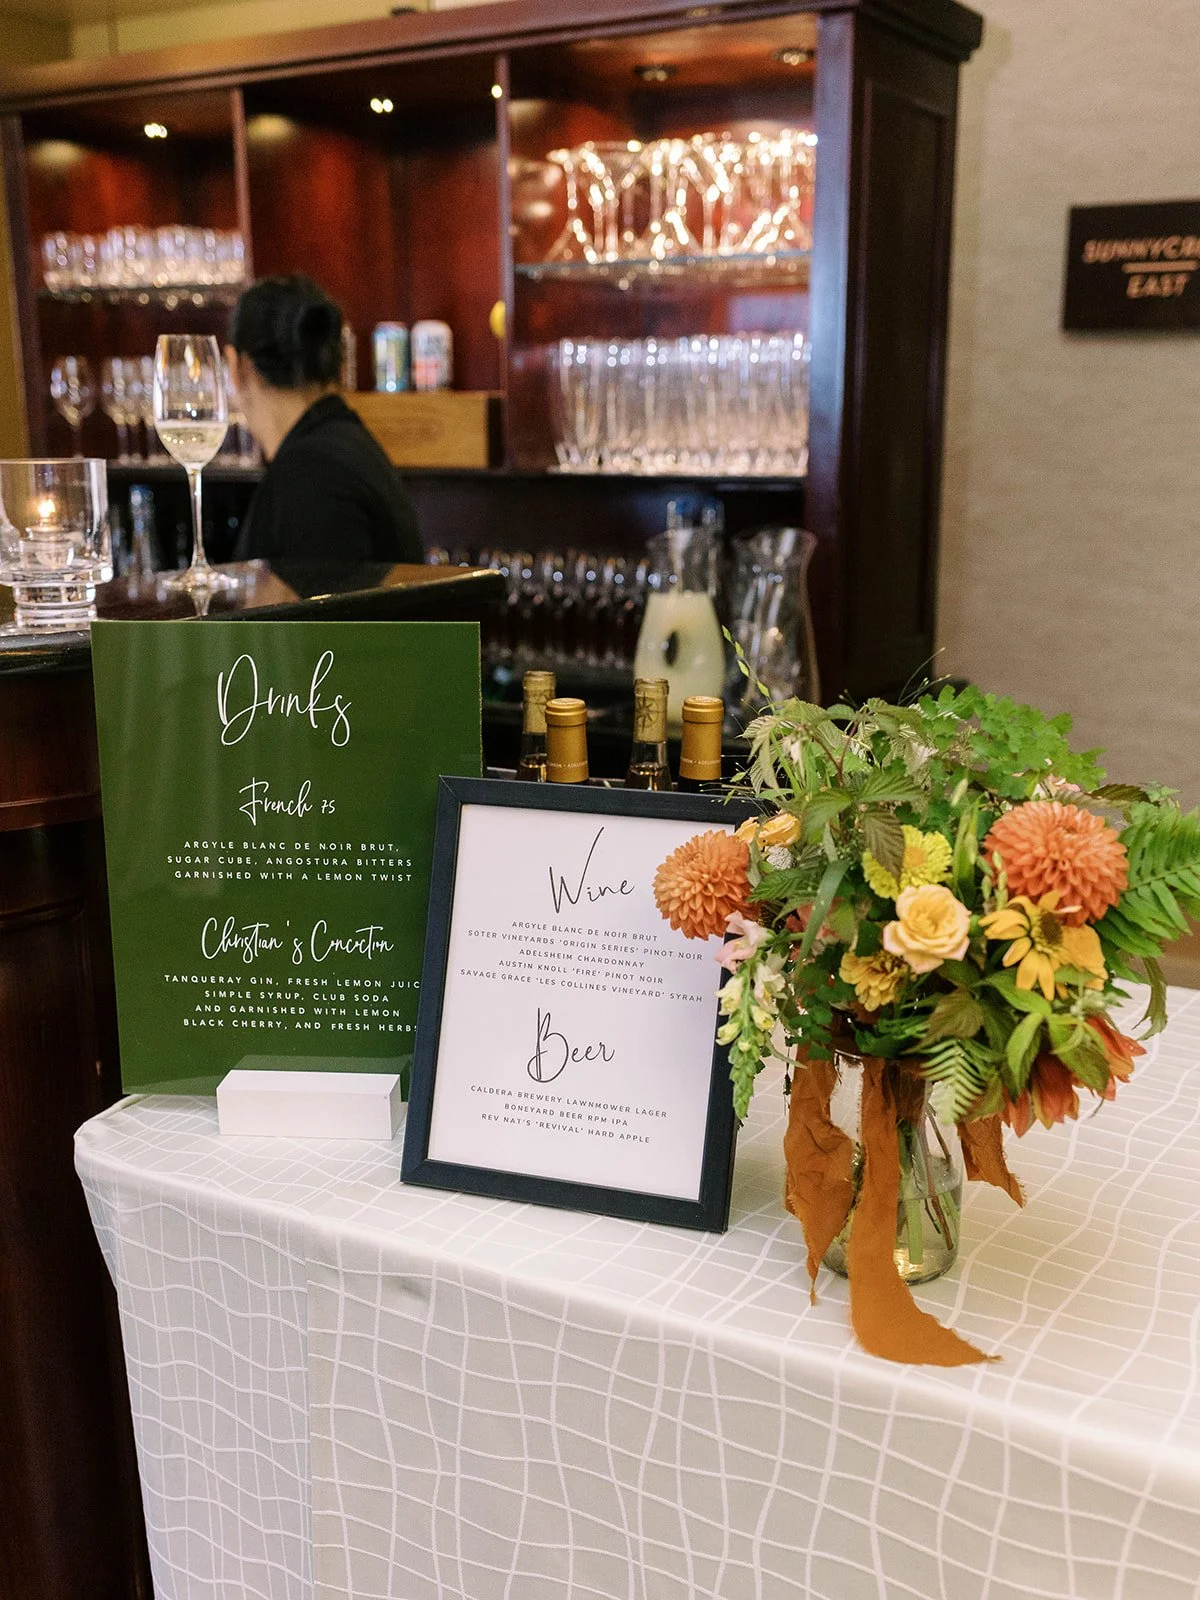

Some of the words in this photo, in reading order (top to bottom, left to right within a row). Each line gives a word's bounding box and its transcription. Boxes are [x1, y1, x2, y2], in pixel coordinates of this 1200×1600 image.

[1081, 235, 1200, 264] SUNNYCR
[1126, 273, 1189, 299] EAST
[217, 650, 352, 747] Drinks
[238, 777, 313, 826] French
[321, 799, 336, 814] 75
[184, 841, 234, 849] ARGYLE
[243, 841, 286, 850] BLANC
[294, 842, 310, 850] DE
[319, 843, 352, 851] NOIR
[361, 843, 399, 852] BRUT,
[167, 855, 210, 864] SUGAR
[218, 856, 258, 865] CUBE,
[266, 857, 348, 866] ANGOSTURA
[356, 858, 412, 867] BITTERS
[549, 826, 635, 914] Wine
[175, 871, 251, 880] GARNISHED
[260, 872, 293, 880] WITH
[301, 872, 308, 880] A
[317, 873, 363, 881] LEMON
[371, 874, 412, 882] TWIST
[310, 919, 394, 962] Concoction
[512, 921, 548, 931] ARGYLE
[552, 926, 583, 934] BLANC
[604, 930, 627, 939] NOIR
[632, 933, 658, 942] BRUT
[468, 930, 497, 939] SOTER
[501, 933, 555, 945] VINEYARDS
[559, 939, 596, 949] 'ORIGIN
[601, 944, 639, 953] SERIES'
[643, 948, 674, 957] PINOT
[678, 952, 703, 961] NOIR
[519, 949, 573, 960] ADELSHEIM
[577, 954, 644, 968] CHARDONNAY
[164, 975, 242, 984] TANQUERAY
[250, 977, 279, 986] GIN,
[288, 978, 328, 986] FRESH
[337, 979, 382, 988] LEMON
[391, 981, 420, 989] JUIC
[499, 960, 533, 969] AUSTIN
[537, 964, 567, 973] KNOLL
[572, 968, 600, 977] 'FIRE'
[605, 971, 635, 981] PINOT
[640, 976, 664, 984] NOIR
[204, 990, 252, 999] SIMPLE
[260, 991, 304, 1000] SYRUP,
[313, 993, 345, 1001] CLUB
[354, 994, 389, 1002] SODA
[460, 968, 497, 978] SAVAGE
[501, 973, 531, 983] GRACE
[536, 977, 556, 986] 'LES
[560, 980, 607, 992] COLLINES
[612, 986, 665, 998] VINEYARD'
[670, 992, 703, 1002] SYRAH
[195, 1005, 221, 1013] AND
[230, 1005, 305, 1015] GARNISHED
[314, 1007, 346, 1015] WITH
[355, 1008, 400, 1017] LEMON
[184, 1018, 224, 1027] BLACK
[232, 1019, 288, 1029] CHERRY,
[295, 1022, 321, 1030] AND
[331, 1023, 370, 1031] FRESH
[526, 1007, 616, 1083] Beer
[470, 1085, 513, 1097] CALDERA
[517, 1091, 563, 1103] BREWERY
[566, 1098, 631, 1113] LAWNMOWER
[635, 1108, 668, 1118] LAGER
[504, 1103, 555, 1116] BONEYARD
[559, 1111, 583, 1120] BEER
[588, 1114, 607, 1123] RPM
[612, 1118, 628, 1127] IPA
[481, 1113, 499, 1122] REV
[503, 1116, 531, 1127] NAT'S
[536, 1121, 584, 1134] 'REVIVAL'
[588, 1128, 615, 1138] HARD
[619, 1133, 650, 1144] APPLE
